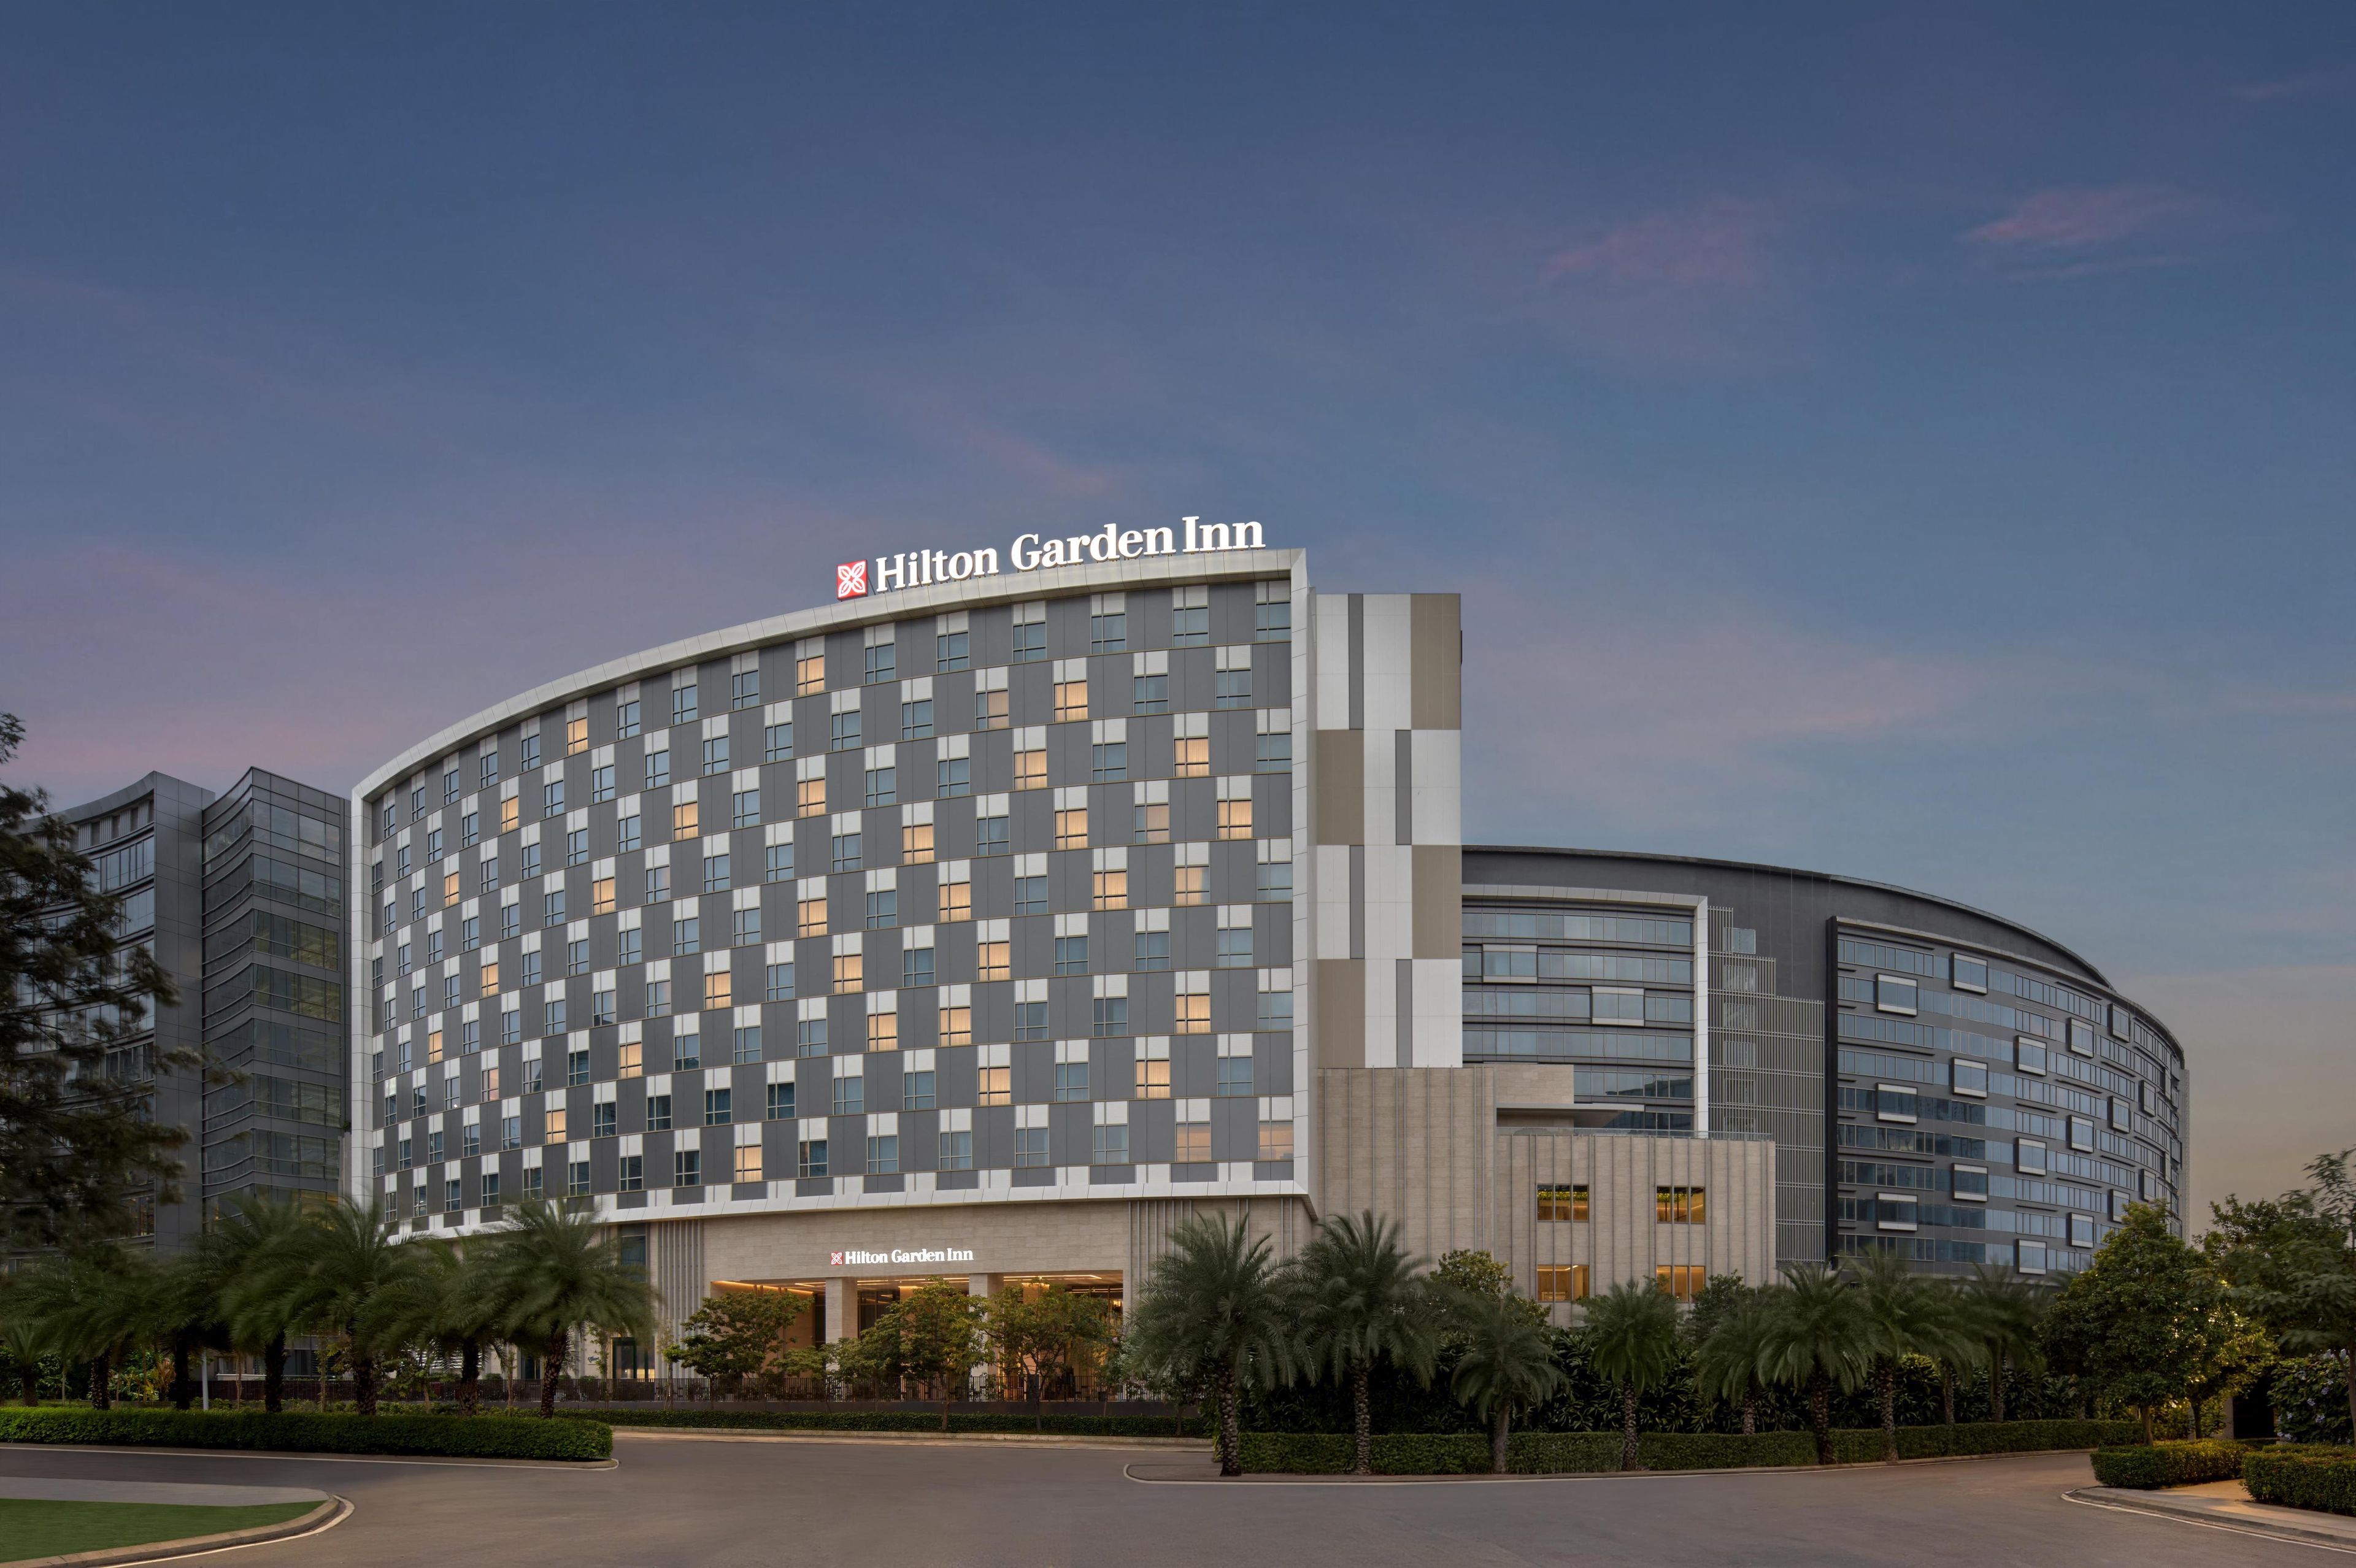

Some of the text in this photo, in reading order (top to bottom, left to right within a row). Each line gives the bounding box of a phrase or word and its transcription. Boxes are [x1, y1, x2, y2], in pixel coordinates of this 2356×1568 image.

[875, 515, 1266, 593] Hilton Garden Inn
[845, 1248, 974, 1264] Hilton Garden Inn
